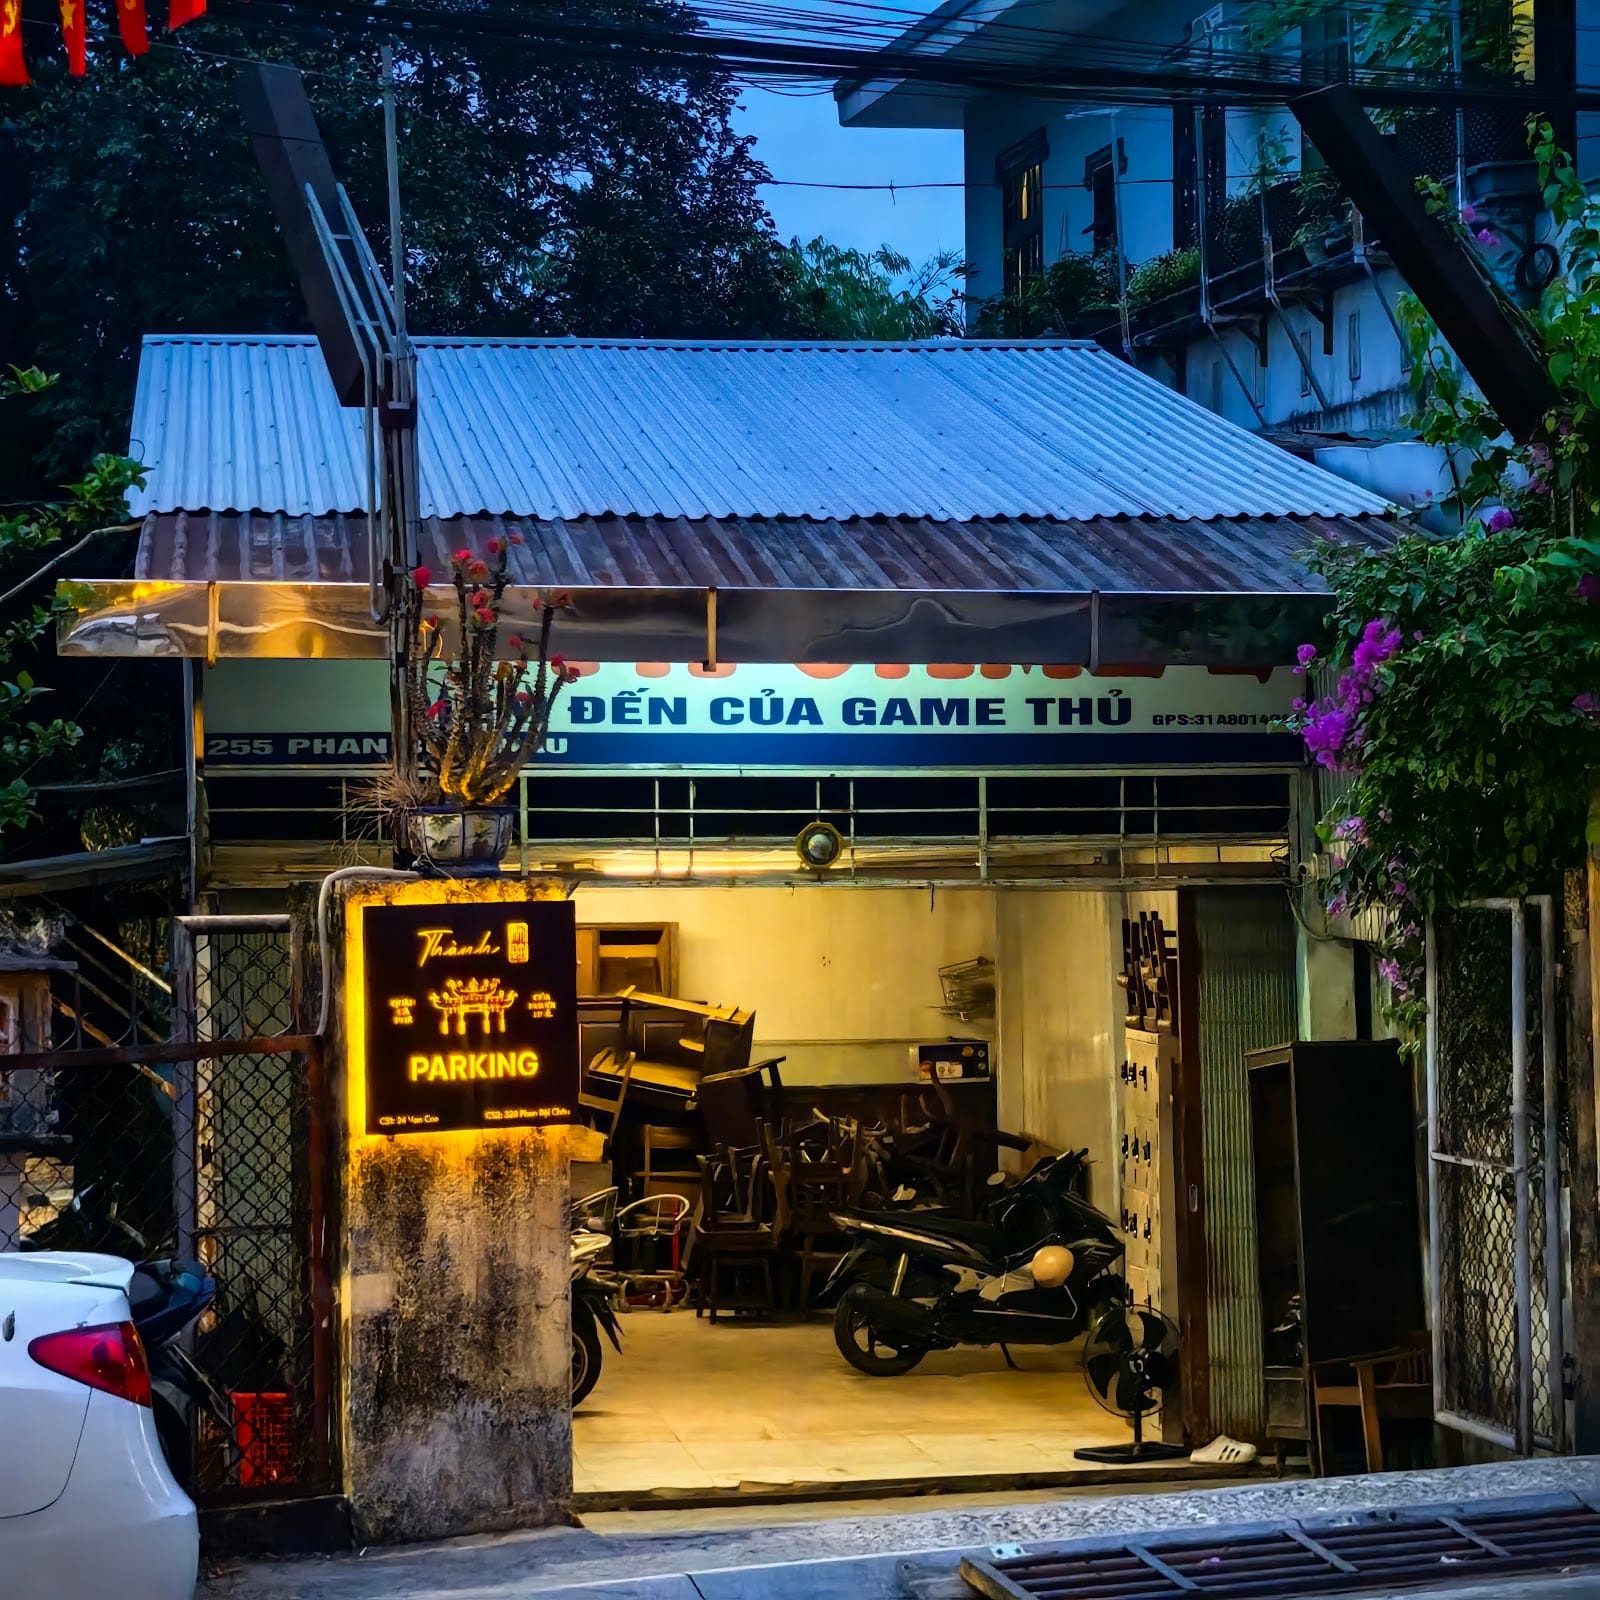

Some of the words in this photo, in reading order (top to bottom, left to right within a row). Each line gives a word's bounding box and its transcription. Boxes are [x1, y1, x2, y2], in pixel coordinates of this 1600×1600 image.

[568, 687, 687, 725] ĐẾN
[708, 688, 824, 726] CỦA
[841, 697, 1006, 726] GAME
[1026, 688, 1133, 726] THỦ
[207, 739, 274, 756] 255
[287, 738, 389, 755] PHAN
[408, 1051, 540, 1082] PARKING
